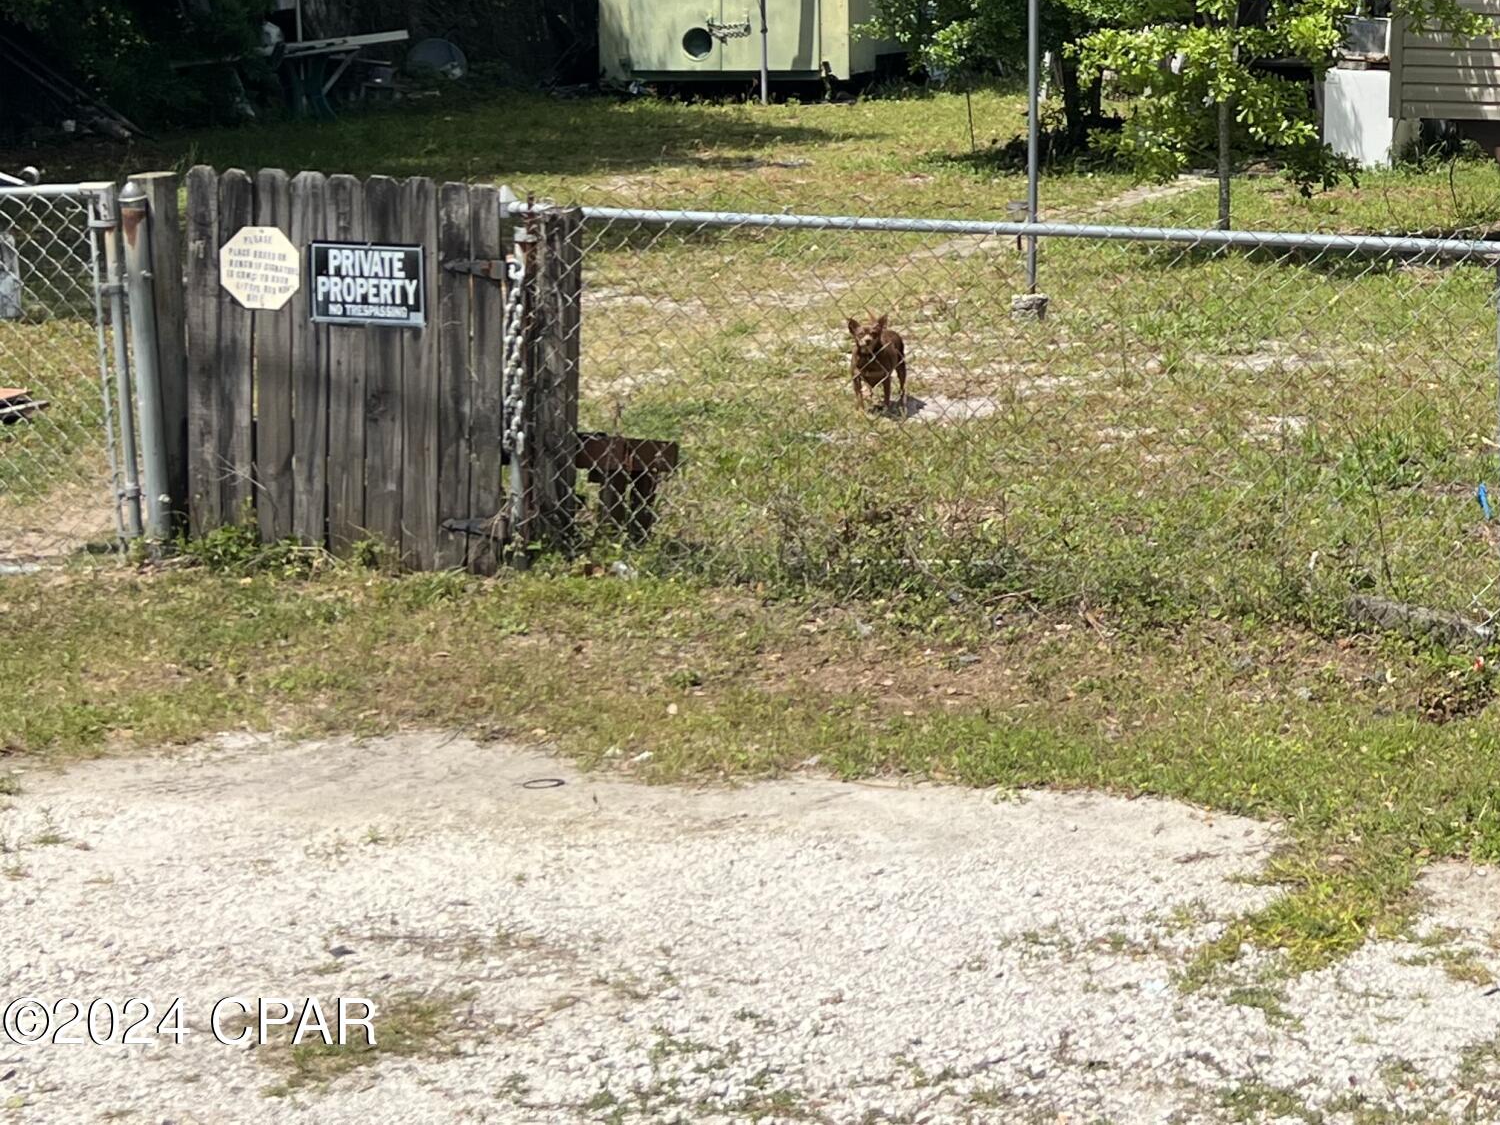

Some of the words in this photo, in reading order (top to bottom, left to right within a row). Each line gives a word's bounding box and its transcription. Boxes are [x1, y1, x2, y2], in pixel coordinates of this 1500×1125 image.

[328, 249, 405, 278] PRIVATE
[316, 275, 418, 305] PROPERTY
[328, 303, 343, 315] NO
[344, 304, 408, 318] TRESPASSING
